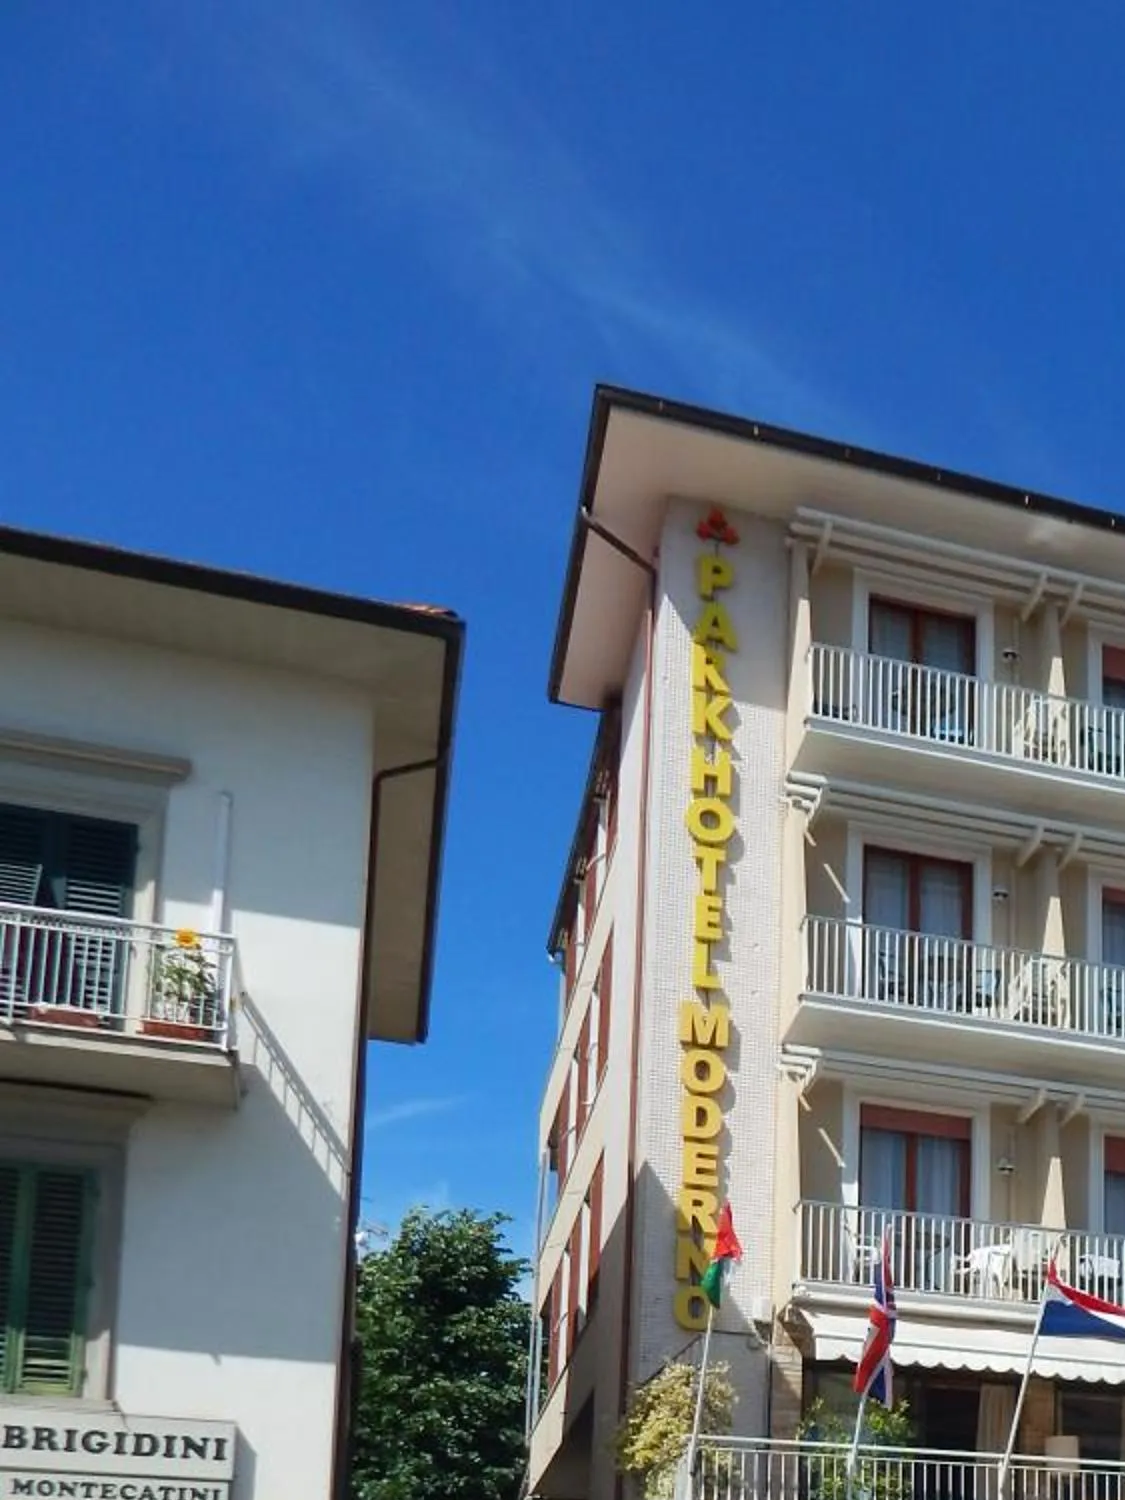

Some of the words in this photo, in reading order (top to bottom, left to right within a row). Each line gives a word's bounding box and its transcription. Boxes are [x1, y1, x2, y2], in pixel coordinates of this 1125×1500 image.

[690, 553, 739, 742] PARK
[685, 745, 735, 992] HOTEL
[672, 999, 729, 1333] MODERNO
[2, 1424, 229, 1461] BRIGIDINI
